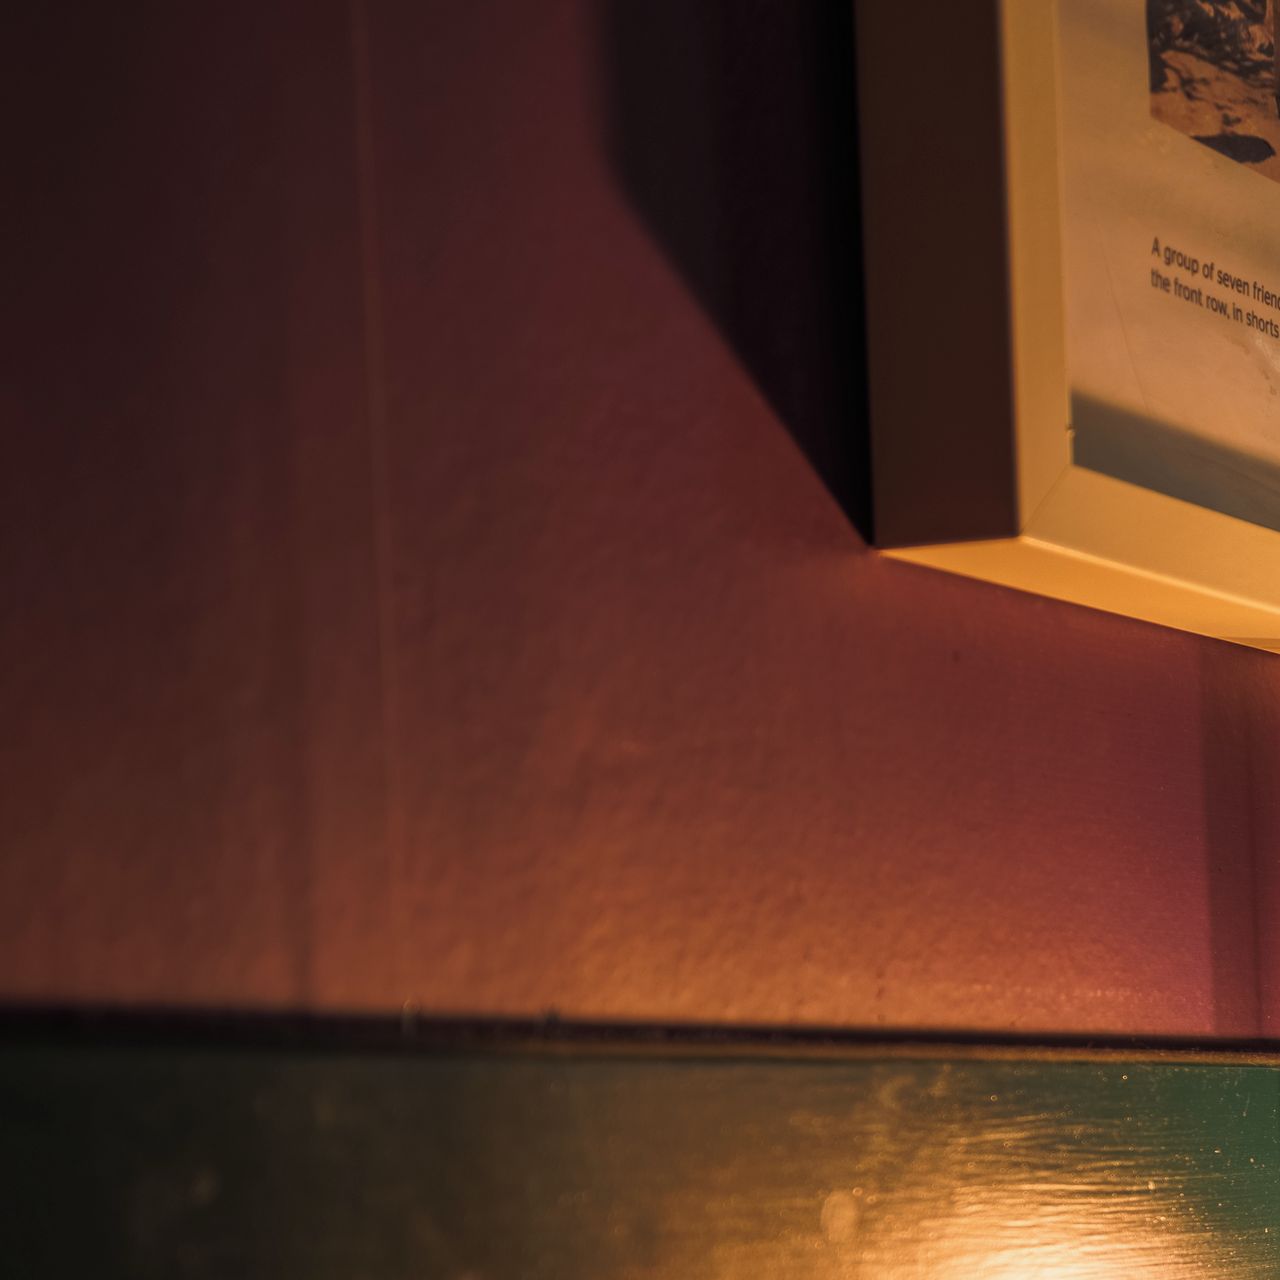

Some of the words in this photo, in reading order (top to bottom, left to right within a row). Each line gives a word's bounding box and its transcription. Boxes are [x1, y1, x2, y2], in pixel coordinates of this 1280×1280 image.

[1152, 236, 1160, 256] A
[1164, 246, 1199, 276] group
[1202, 262, 1214, 281] of
[1217, 269, 1250, 296] seven
[1151, 269, 1171, 294] the
[1174, 277, 1203, 307] front
[1206, 295, 1230, 320] row,
[1232, 302, 1243, 324] in
[1246, 310, 1279, 339] shorts
